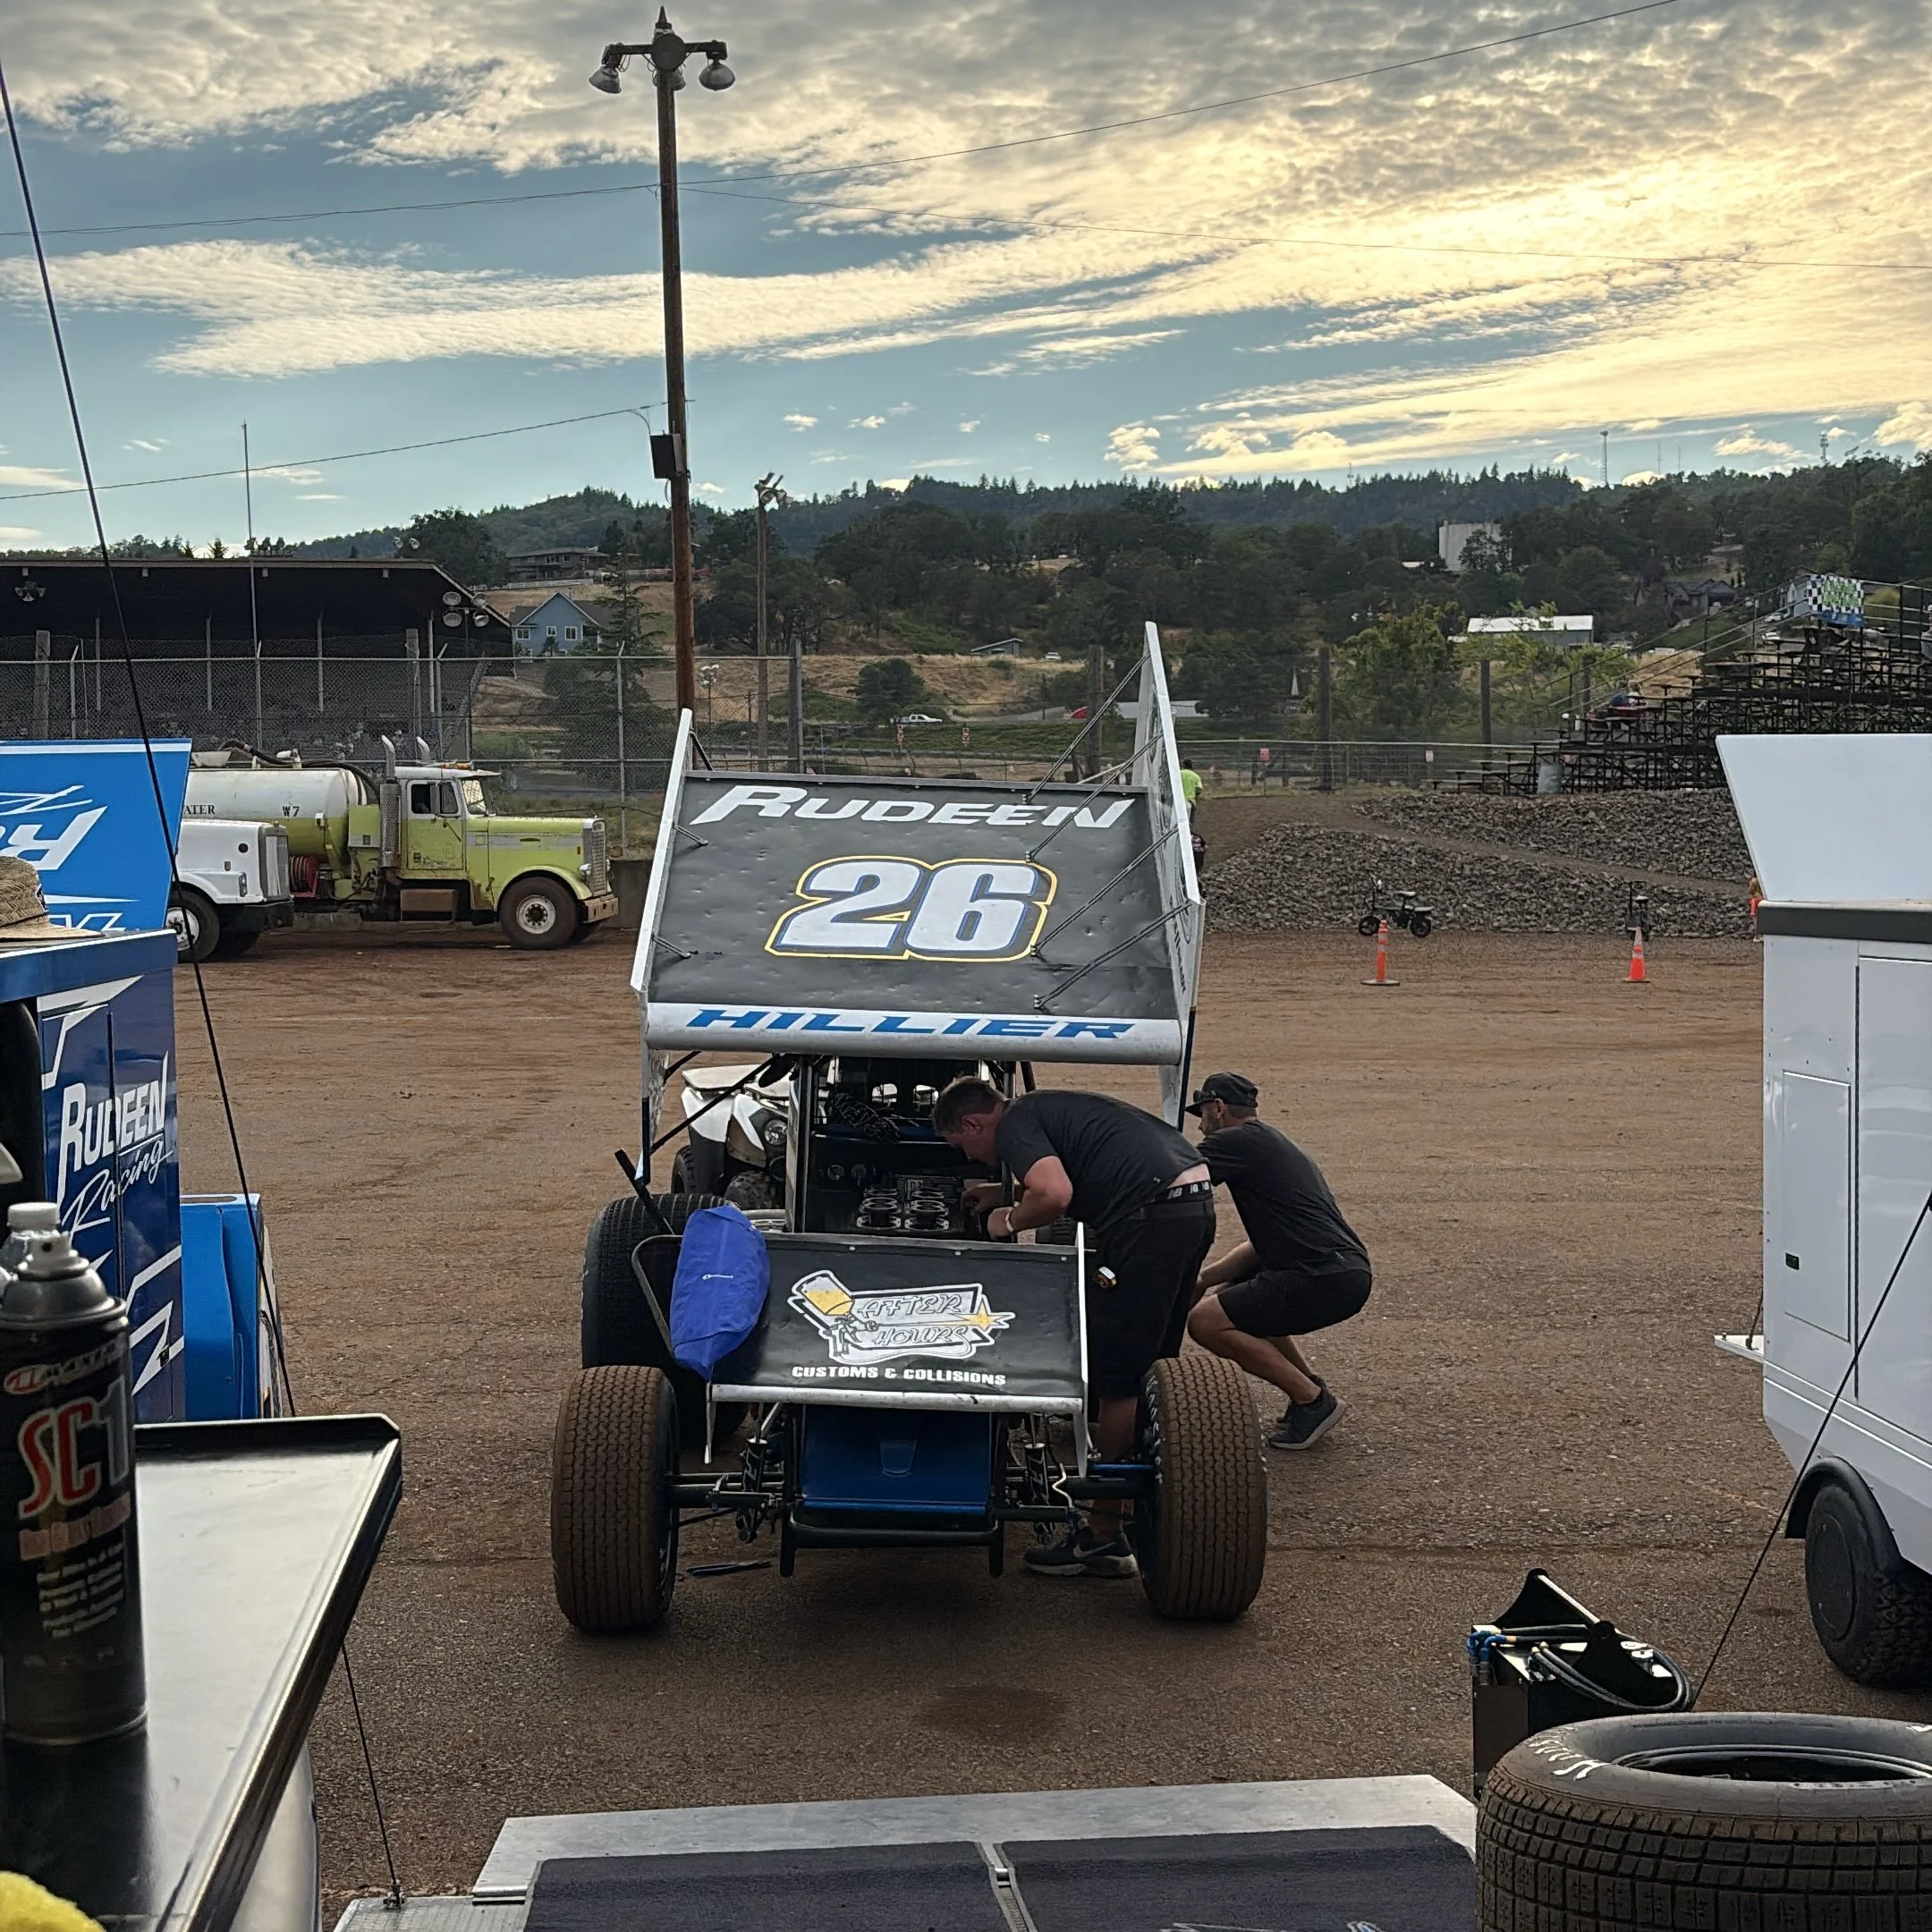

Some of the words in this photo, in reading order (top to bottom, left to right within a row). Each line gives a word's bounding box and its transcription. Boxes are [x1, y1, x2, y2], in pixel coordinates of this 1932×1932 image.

[182, 804, 215, 815] ATER
[689, 785, 1135, 828] RUDEEN
[766, 856, 1055, 961] 26
[685, 1008, 1136, 1040] HILLIER
[57, 1050, 168, 1208] RUDEEN
[62, 1140, 173, 1245] Racing
[857, 1293, 962, 1318] AFTER
[872, 1326, 970, 1346] HOURS
[792, 1366, 878, 1378] CUSTOMS
[885, 1367, 896, 1378] &
[903, 1368, 1006, 1385] COLLISIONS
[18, 1374, 130, 1520] SC1
